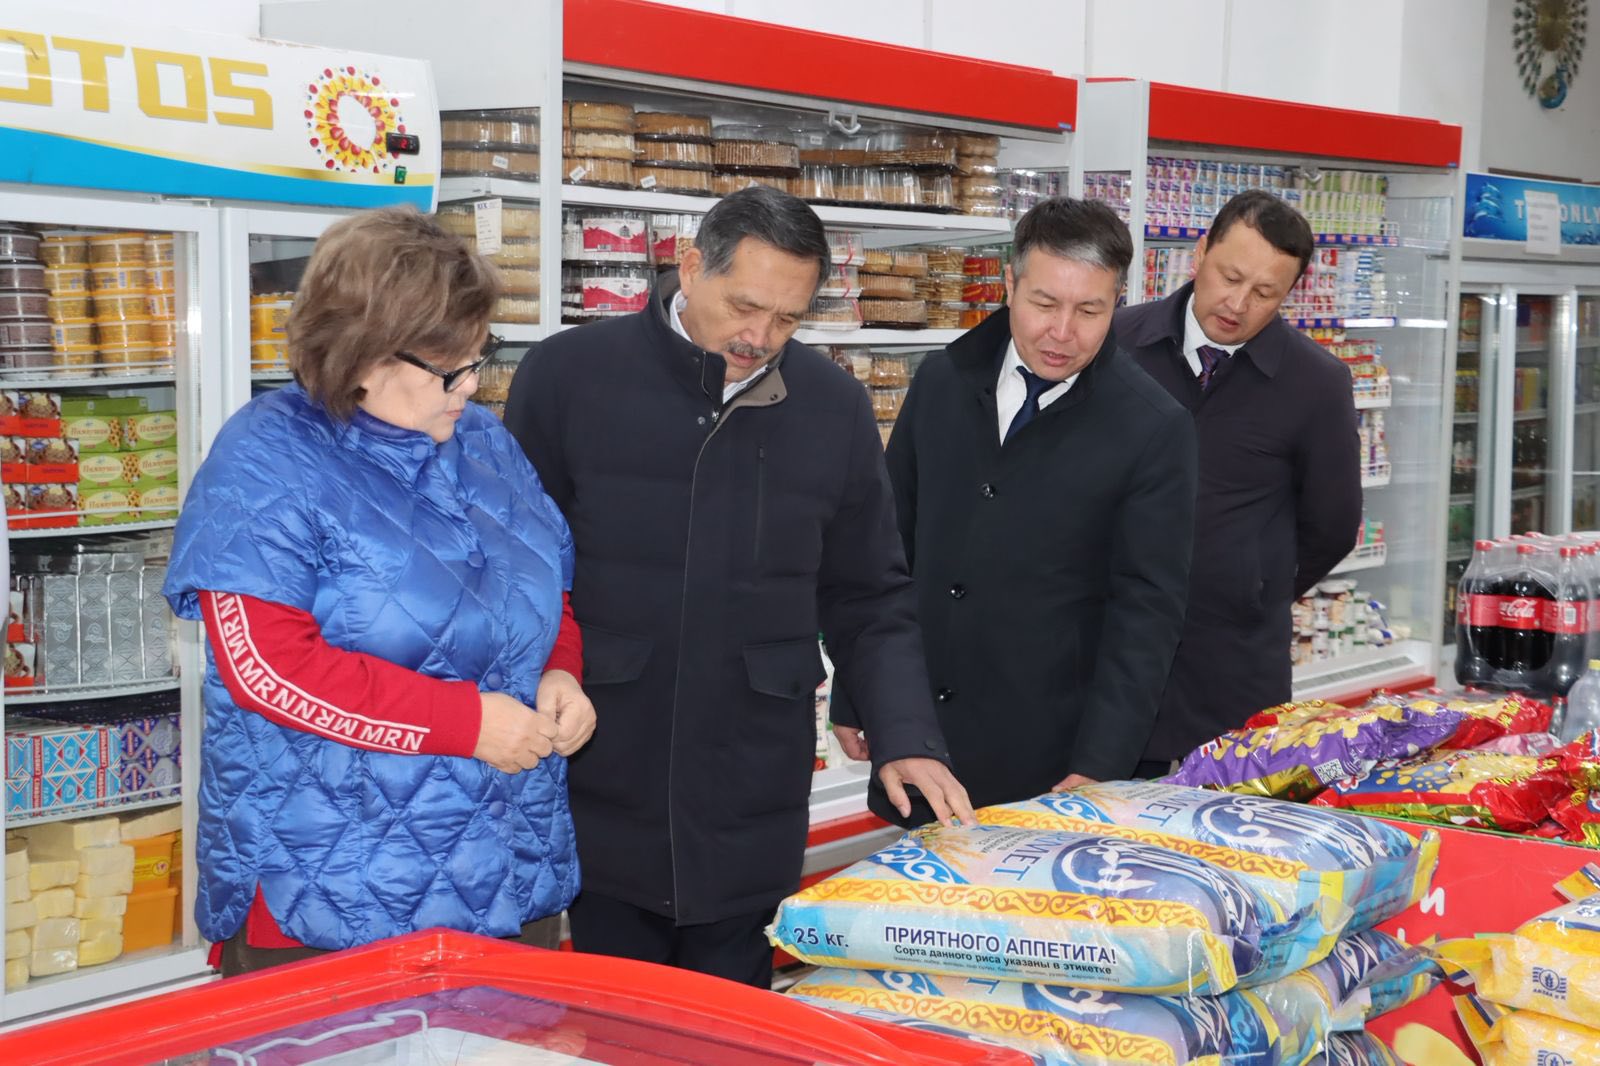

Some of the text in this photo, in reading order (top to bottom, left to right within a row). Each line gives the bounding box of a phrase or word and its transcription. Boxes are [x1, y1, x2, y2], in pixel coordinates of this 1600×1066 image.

[359, 724, 425, 751] MRN
[793, 928, 819, 945] 25
[885, 926, 1117, 965] ПРИЯТНОГО АППЕТИТА!
[895, 944, 927, 957] Сорта
[930, 949, 973, 961] данного
[975, 954, 1002, 964] риса
[1003, 957, 1051, 969] указаны
[1063, 963, 1112, 975] этикетке
